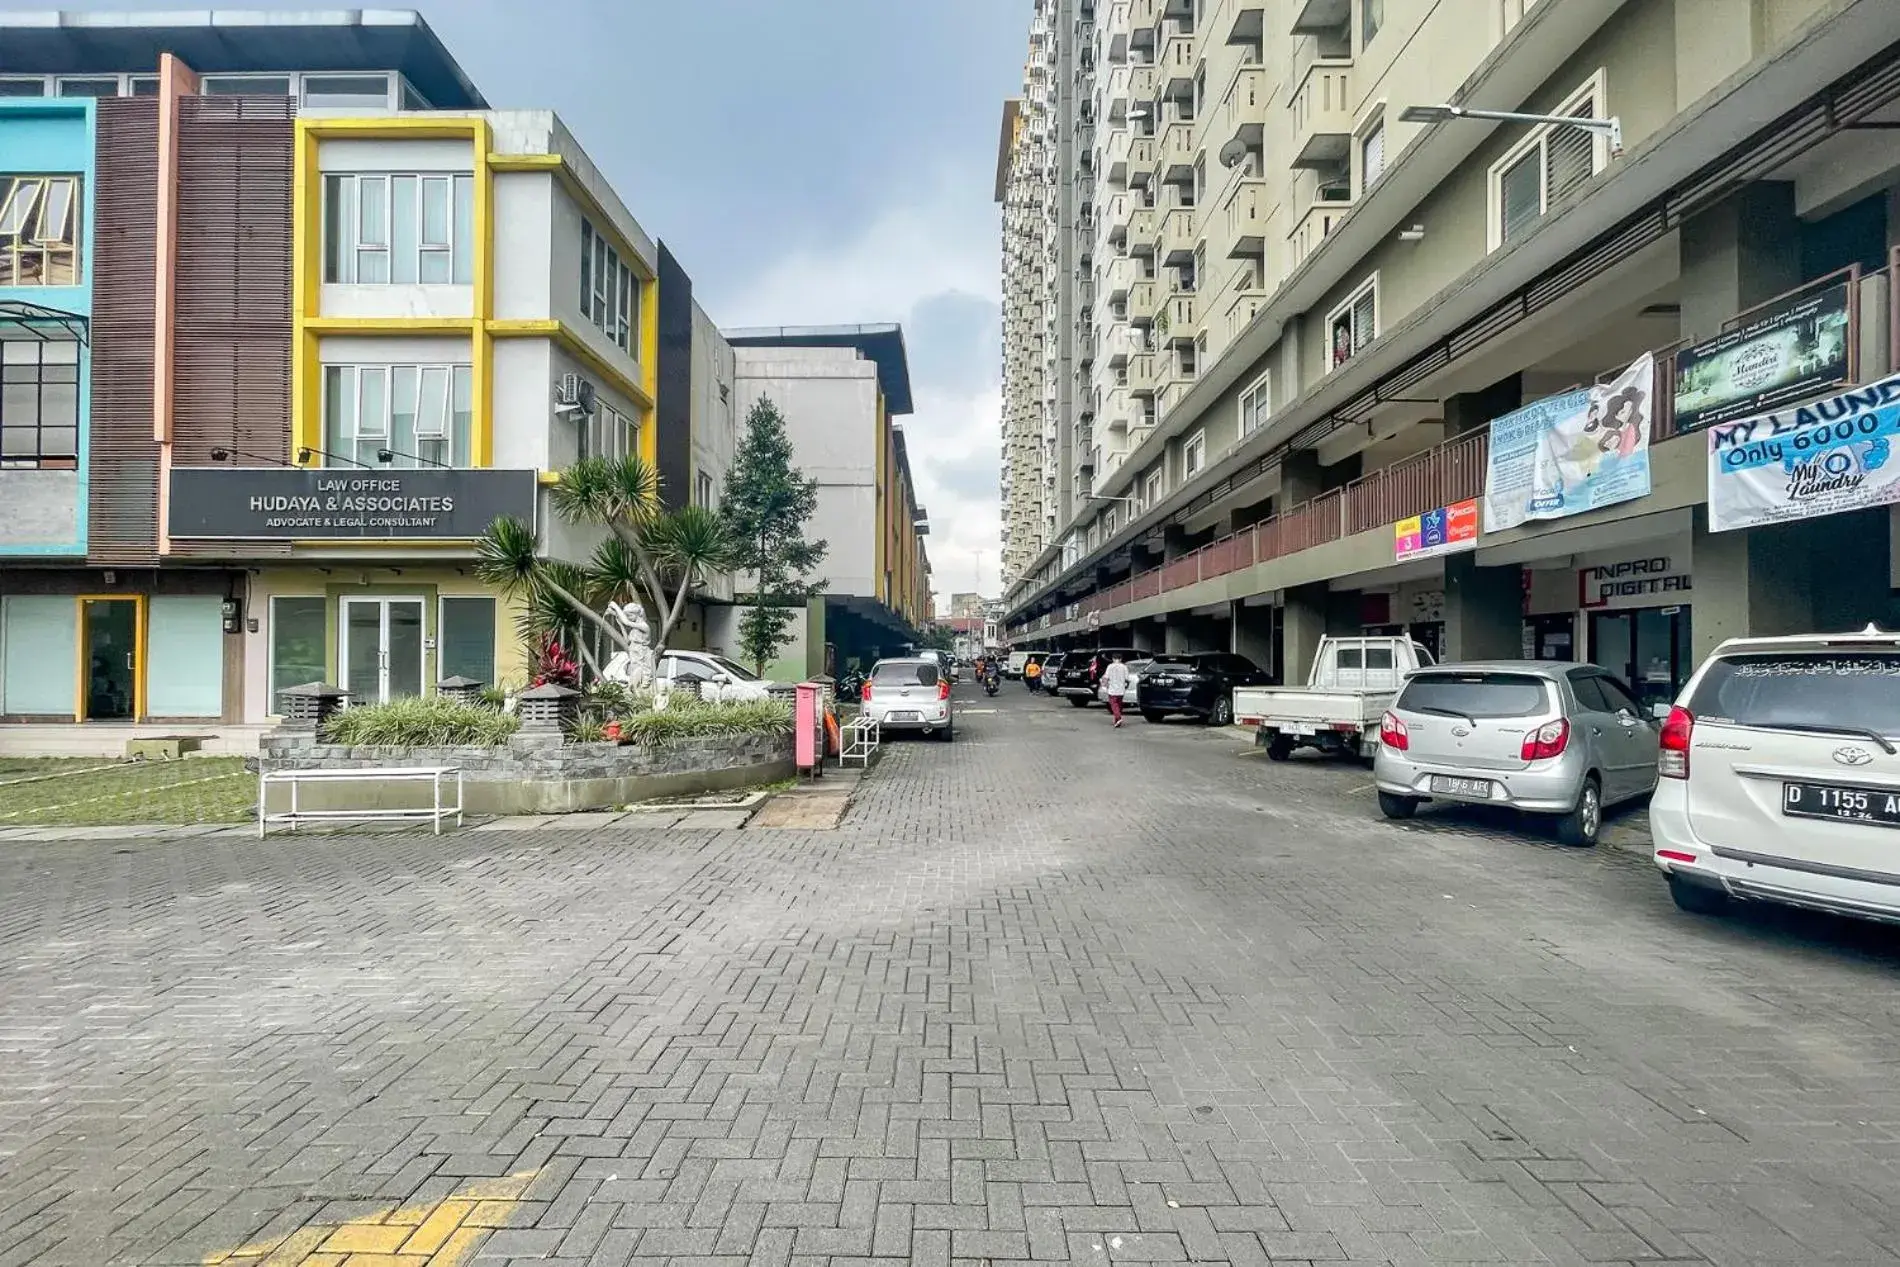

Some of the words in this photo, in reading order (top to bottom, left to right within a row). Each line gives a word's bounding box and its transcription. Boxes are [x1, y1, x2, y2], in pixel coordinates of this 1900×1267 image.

[1714, 420, 1758, 449] MY
[1726, 441, 1783, 466] Only
[1793, 412, 1878, 450] 6000
[1791, 463, 1819, 484] My
[317, 480, 348, 491] LAW
[351, 480, 400, 491] OFFICE
[1785, 473, 1866, 501] Laundry
[250, 496, 320, 511] HUDAYA
[326, 496, 339, 511] &
[342, 496, 453, 511] ASSOCIATES
[265, 518, 322, 527] ADVOCATE
[323, 518, 332, 527] &
[333, 518, 367, 527] LEGAL
[369, 518, 436, 527] CONSULTANT
[1600, 575, 1692, 597] DIGITAL
[1788, 786, 1801, 803] D
[1820, 789, 1868, 809] 1155
[1884, 796, 1900, 813] A
